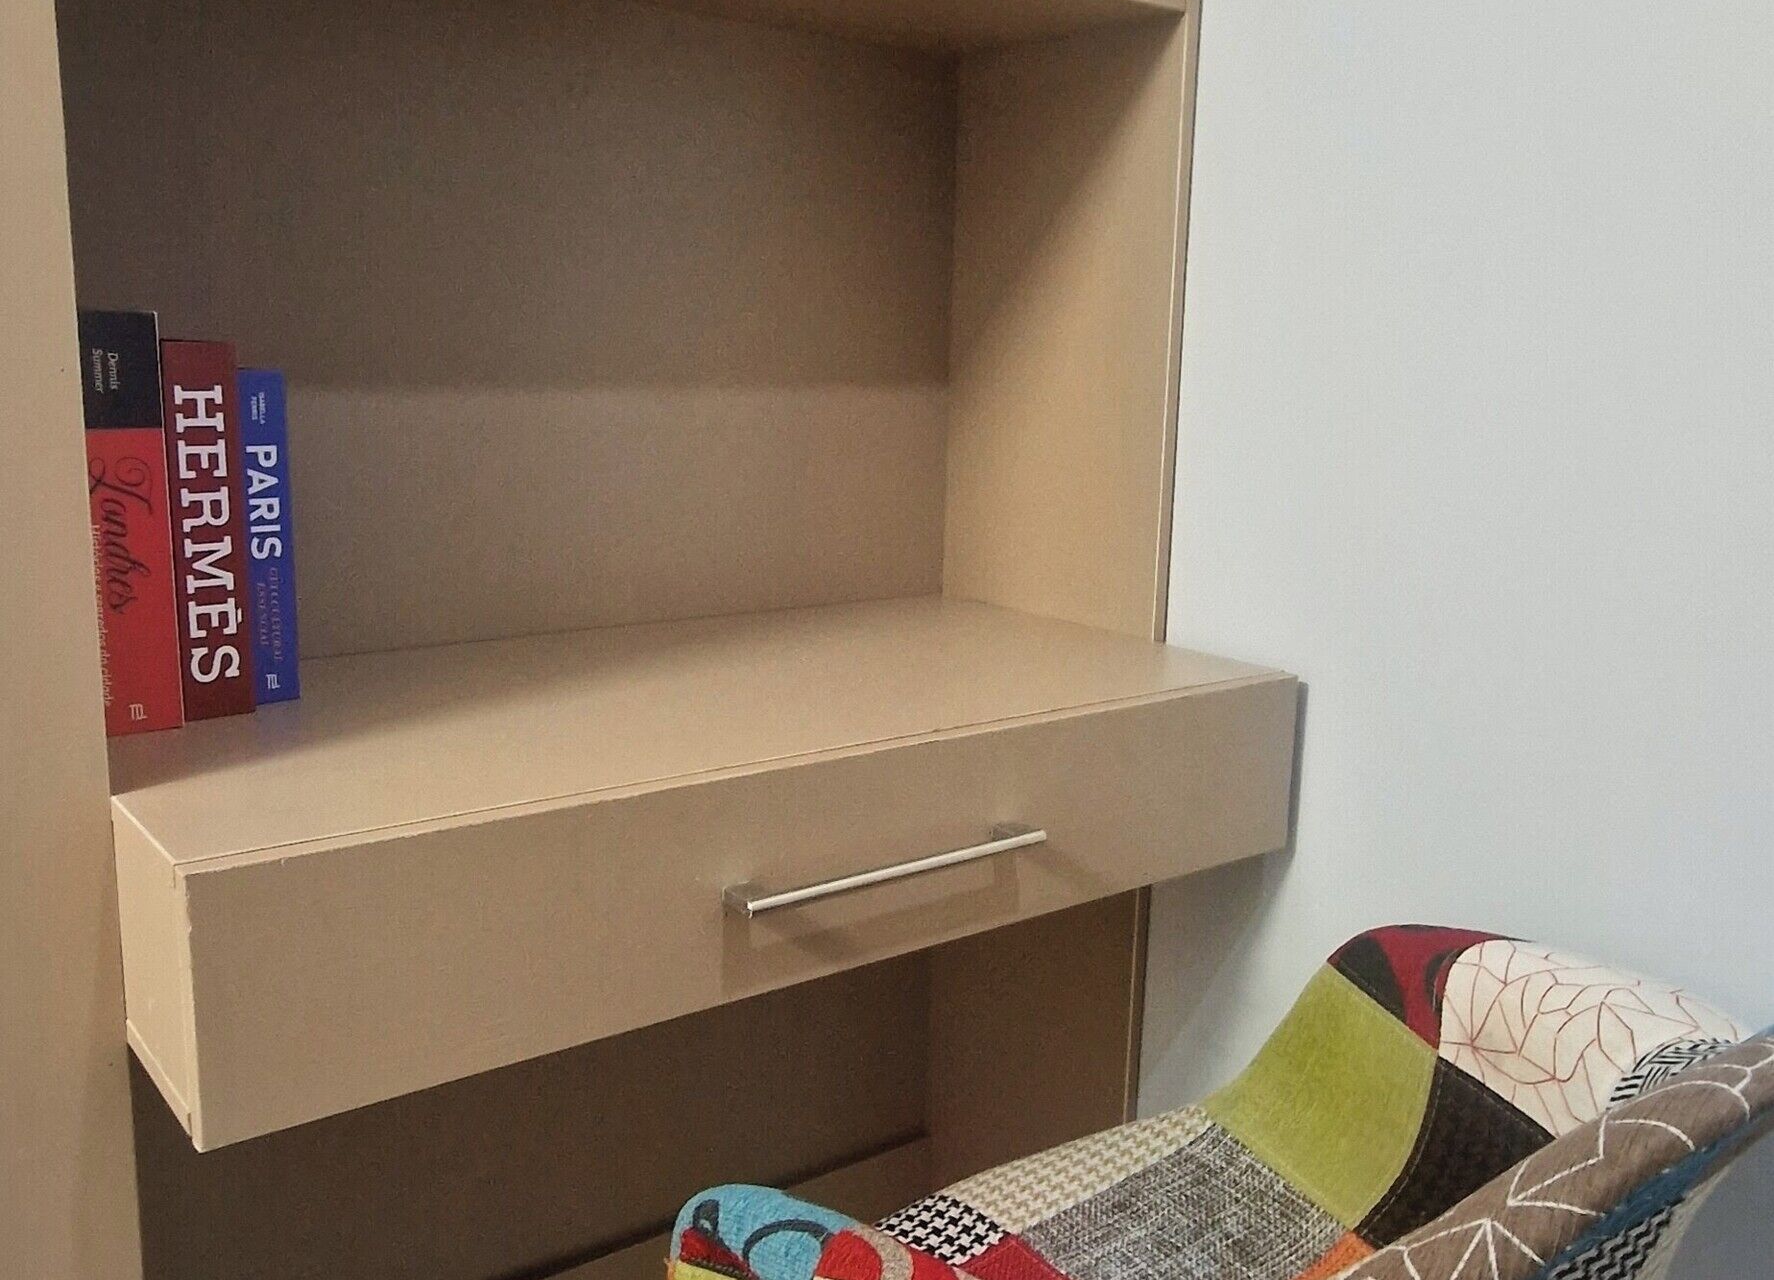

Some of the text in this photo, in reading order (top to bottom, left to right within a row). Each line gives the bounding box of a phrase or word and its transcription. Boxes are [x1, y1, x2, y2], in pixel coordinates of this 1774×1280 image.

[92, 347, 105, 394] Summer
[107, 352, 120, 390] Dennis
[245, 444, 283, 560] PARIS
